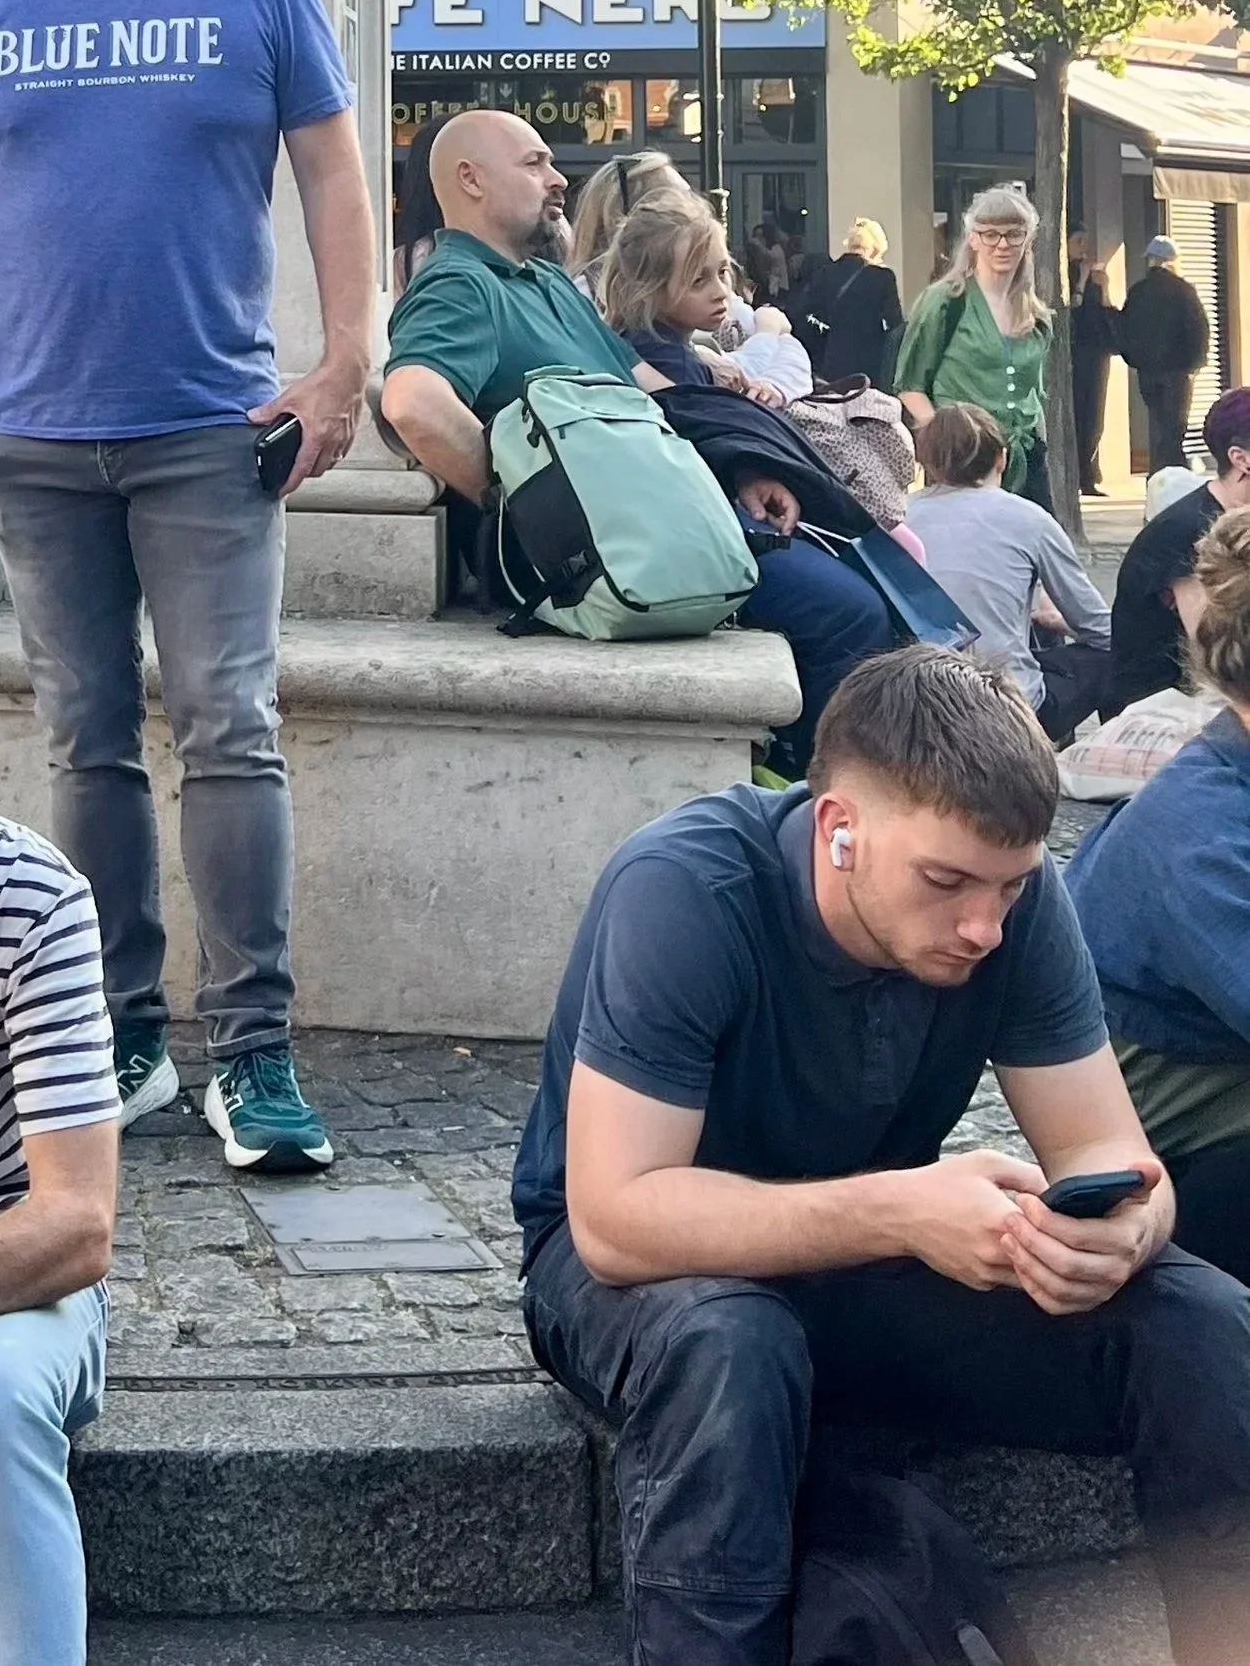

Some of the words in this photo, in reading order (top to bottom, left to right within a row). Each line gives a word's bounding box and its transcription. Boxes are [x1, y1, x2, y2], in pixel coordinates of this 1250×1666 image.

[109, 17, 224, 66] NOTE
[412, 53, 492, 70] ITALIAN
[500, 52, 577, 70] COFFEE
[14, 79, 74, 92] STRAIGHT
[77, 75, 136, 87] BOURBON
[139, 72, 196, 84] WHISKEY
